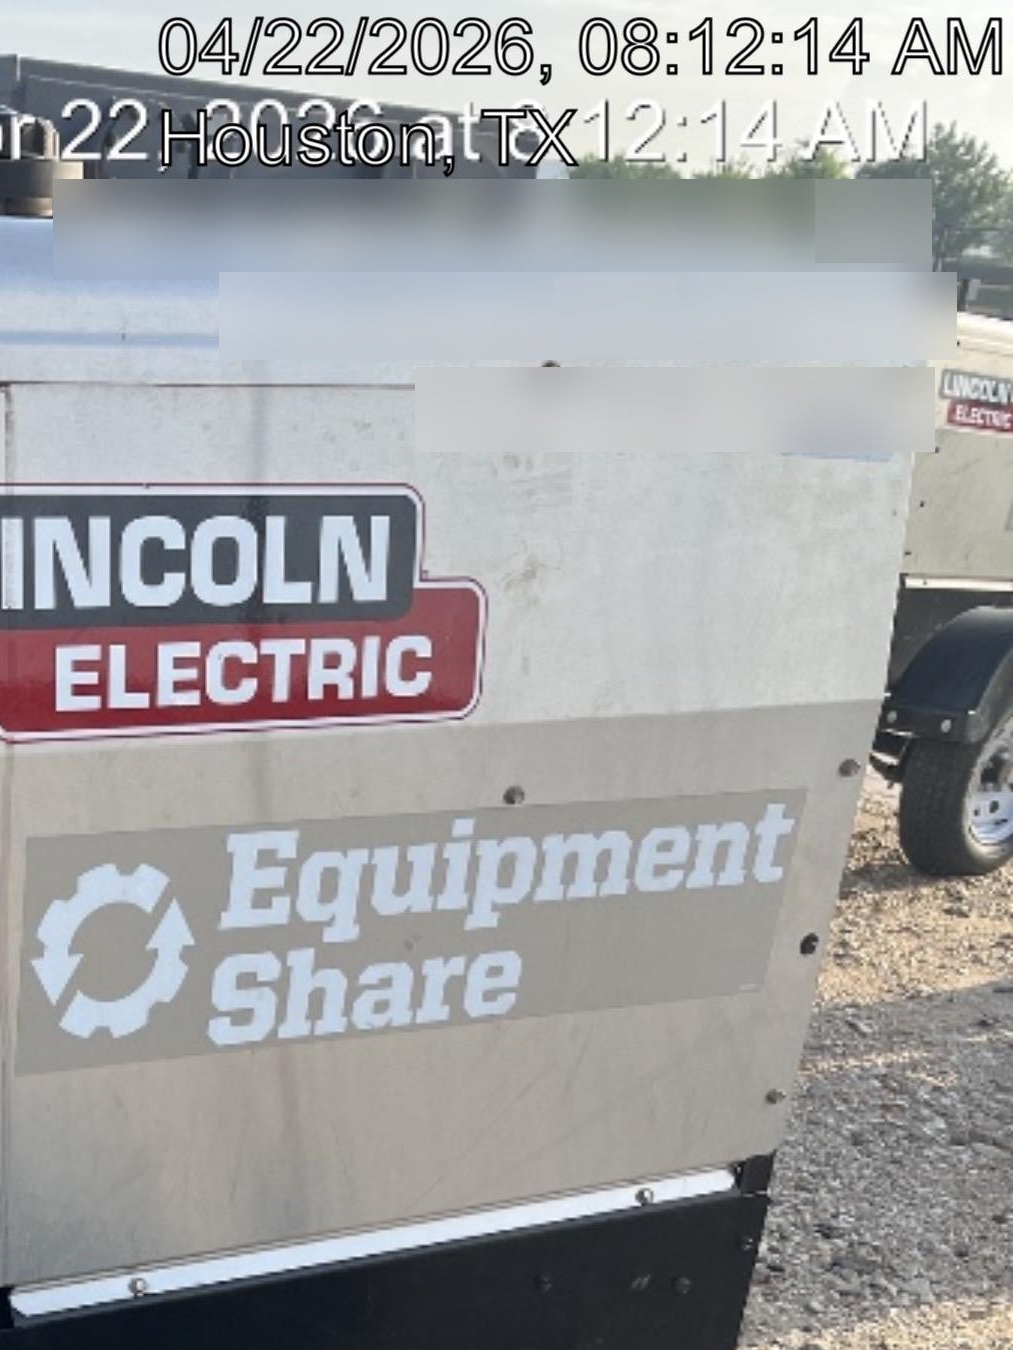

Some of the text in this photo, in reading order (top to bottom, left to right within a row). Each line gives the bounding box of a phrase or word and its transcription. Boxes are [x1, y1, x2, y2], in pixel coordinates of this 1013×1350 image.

[55, 635, 433, 713] ELECTRIC
[218, 803, 795, 944] Equipment
[206, 948, 523, 1047] Share
